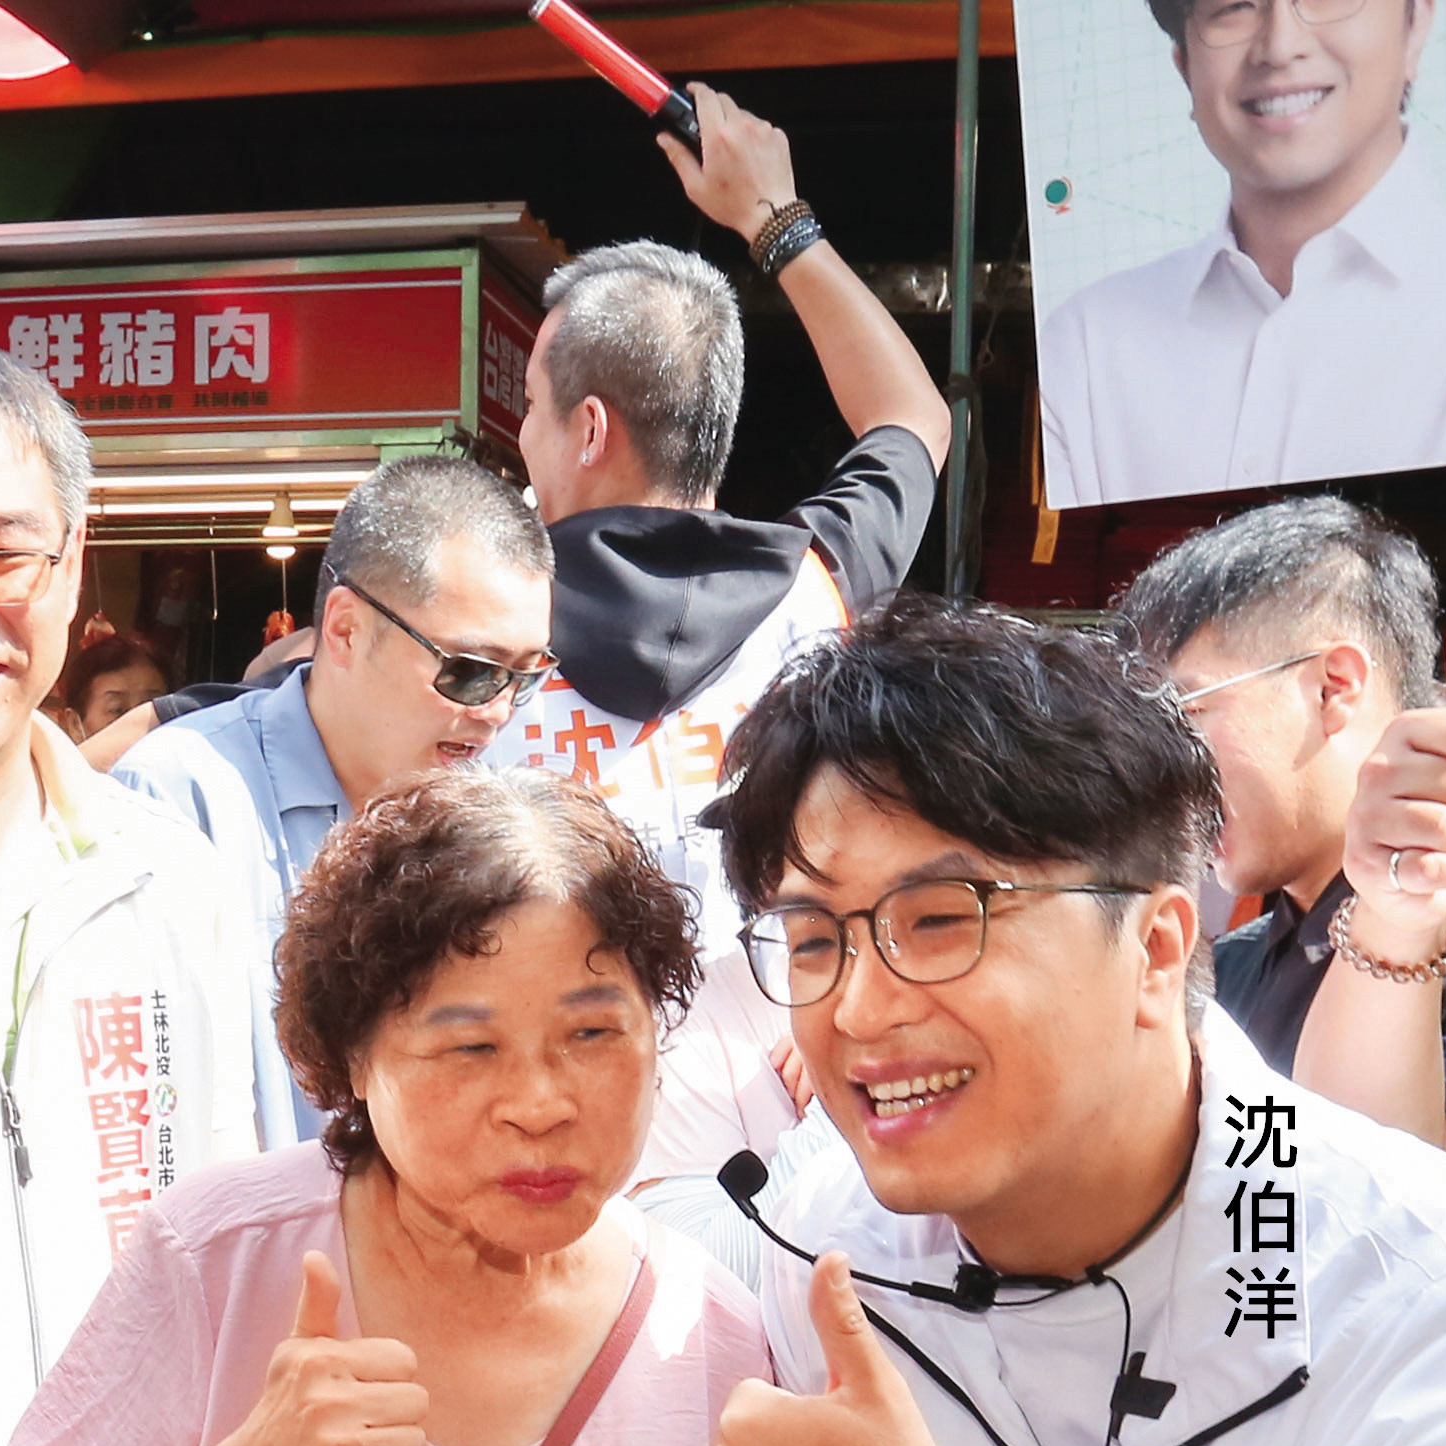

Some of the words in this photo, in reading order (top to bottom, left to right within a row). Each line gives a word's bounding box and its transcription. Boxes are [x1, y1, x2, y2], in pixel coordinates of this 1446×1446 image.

[524, 703, 751, 799] 沈伯
[157, 1124, 175, 1193] 台北市
